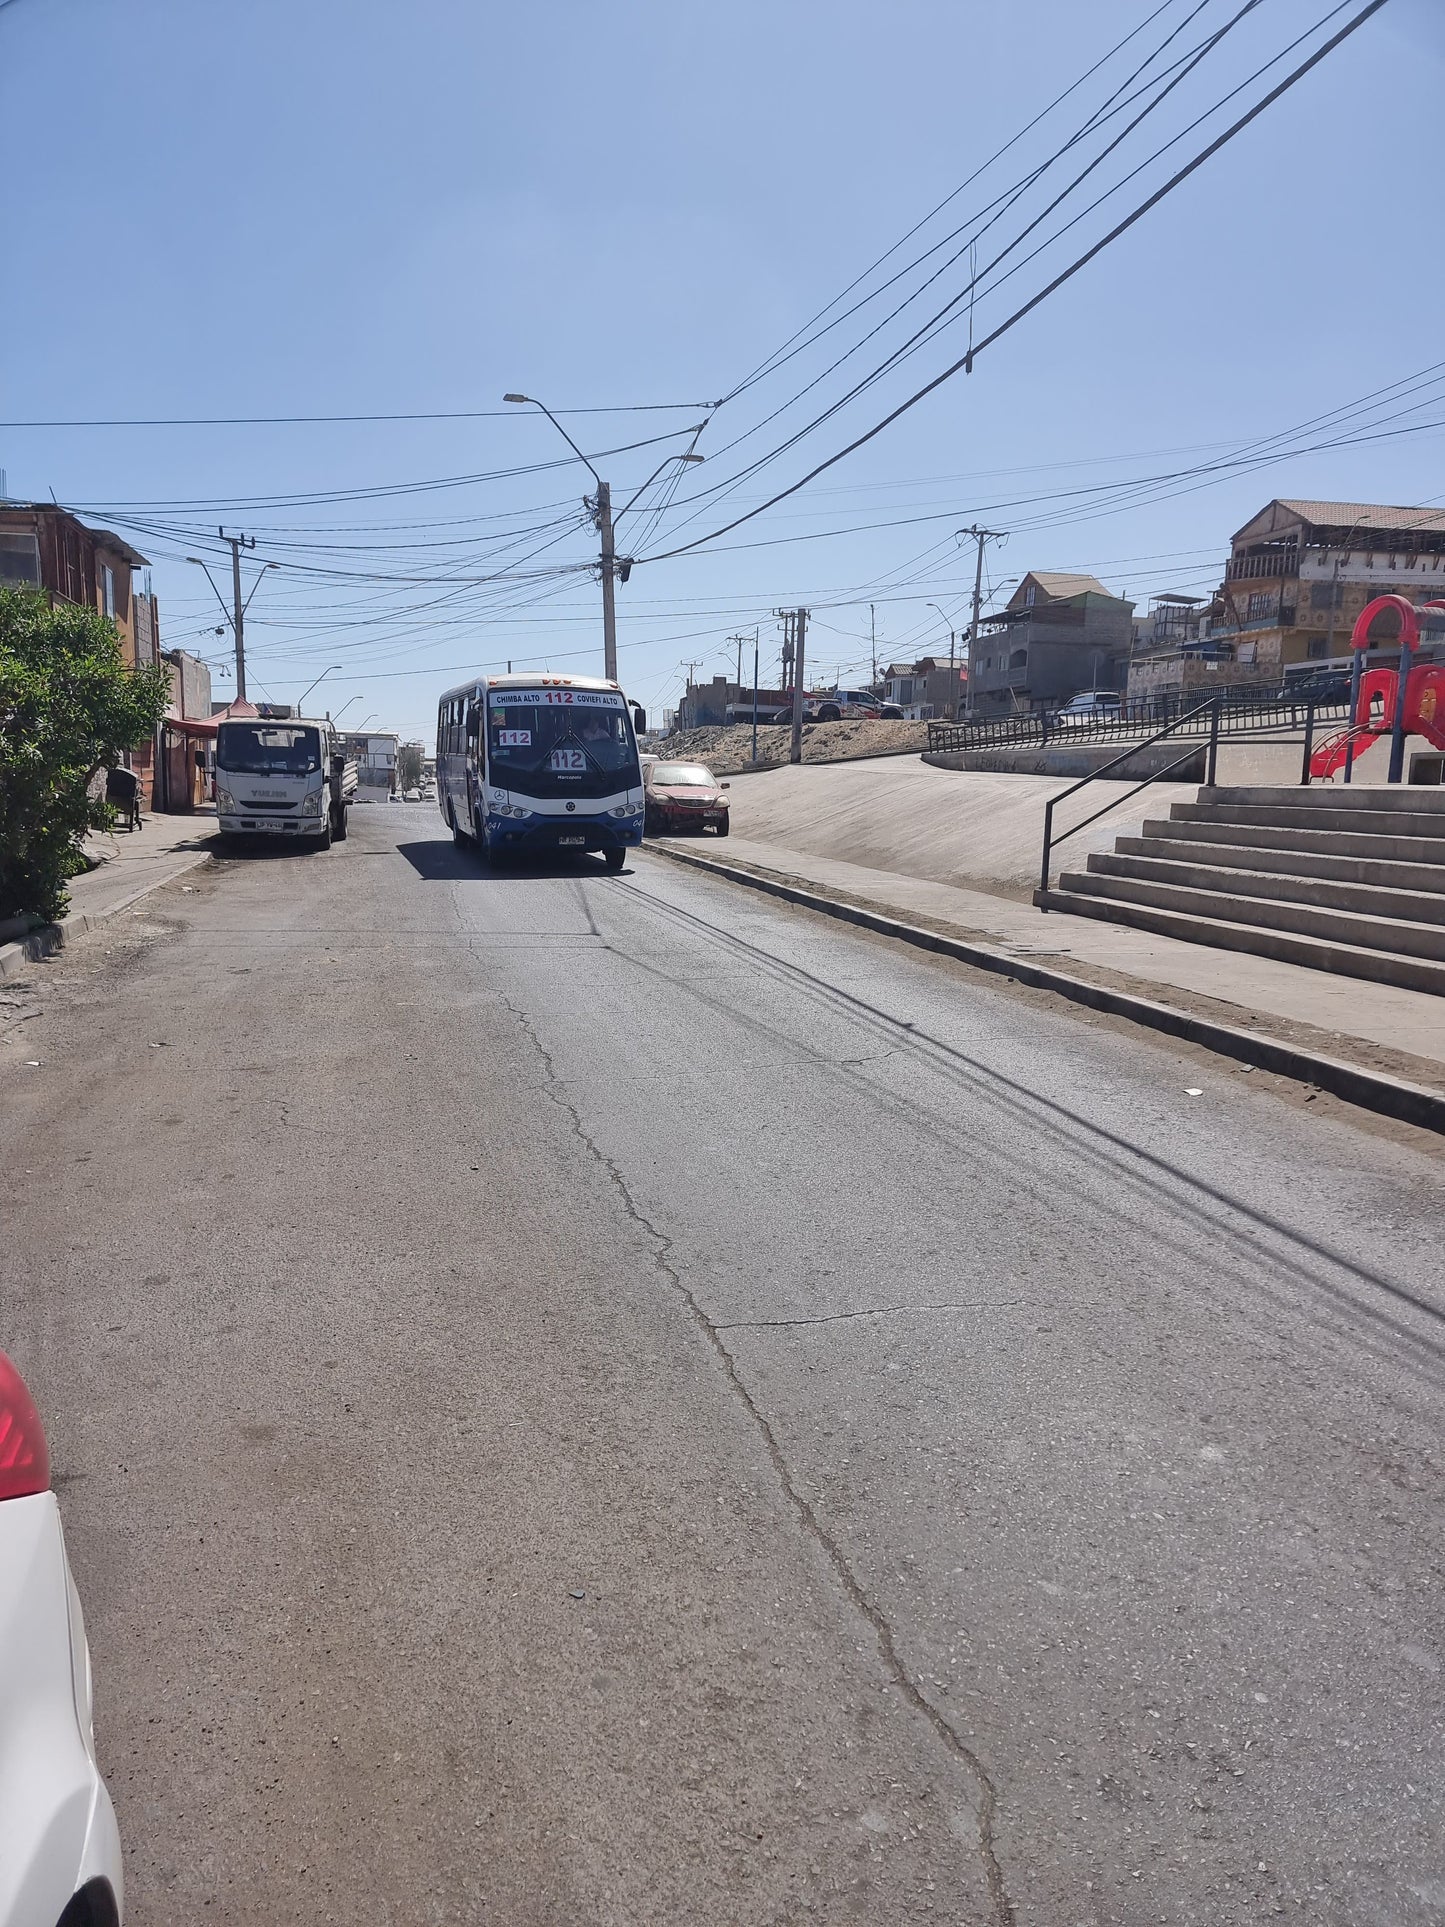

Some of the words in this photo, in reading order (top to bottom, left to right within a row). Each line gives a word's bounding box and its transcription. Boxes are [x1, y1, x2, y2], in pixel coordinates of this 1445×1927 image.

[523, 694, 540, 702] ALTO
[545, 692, 574, 704] 112
[577, 695, 601, 704] COVIEFI
[602, 697, 618, 705] ALTO
[500, 732, 530, 744] 112
[552, 750, 584, 768] 112
